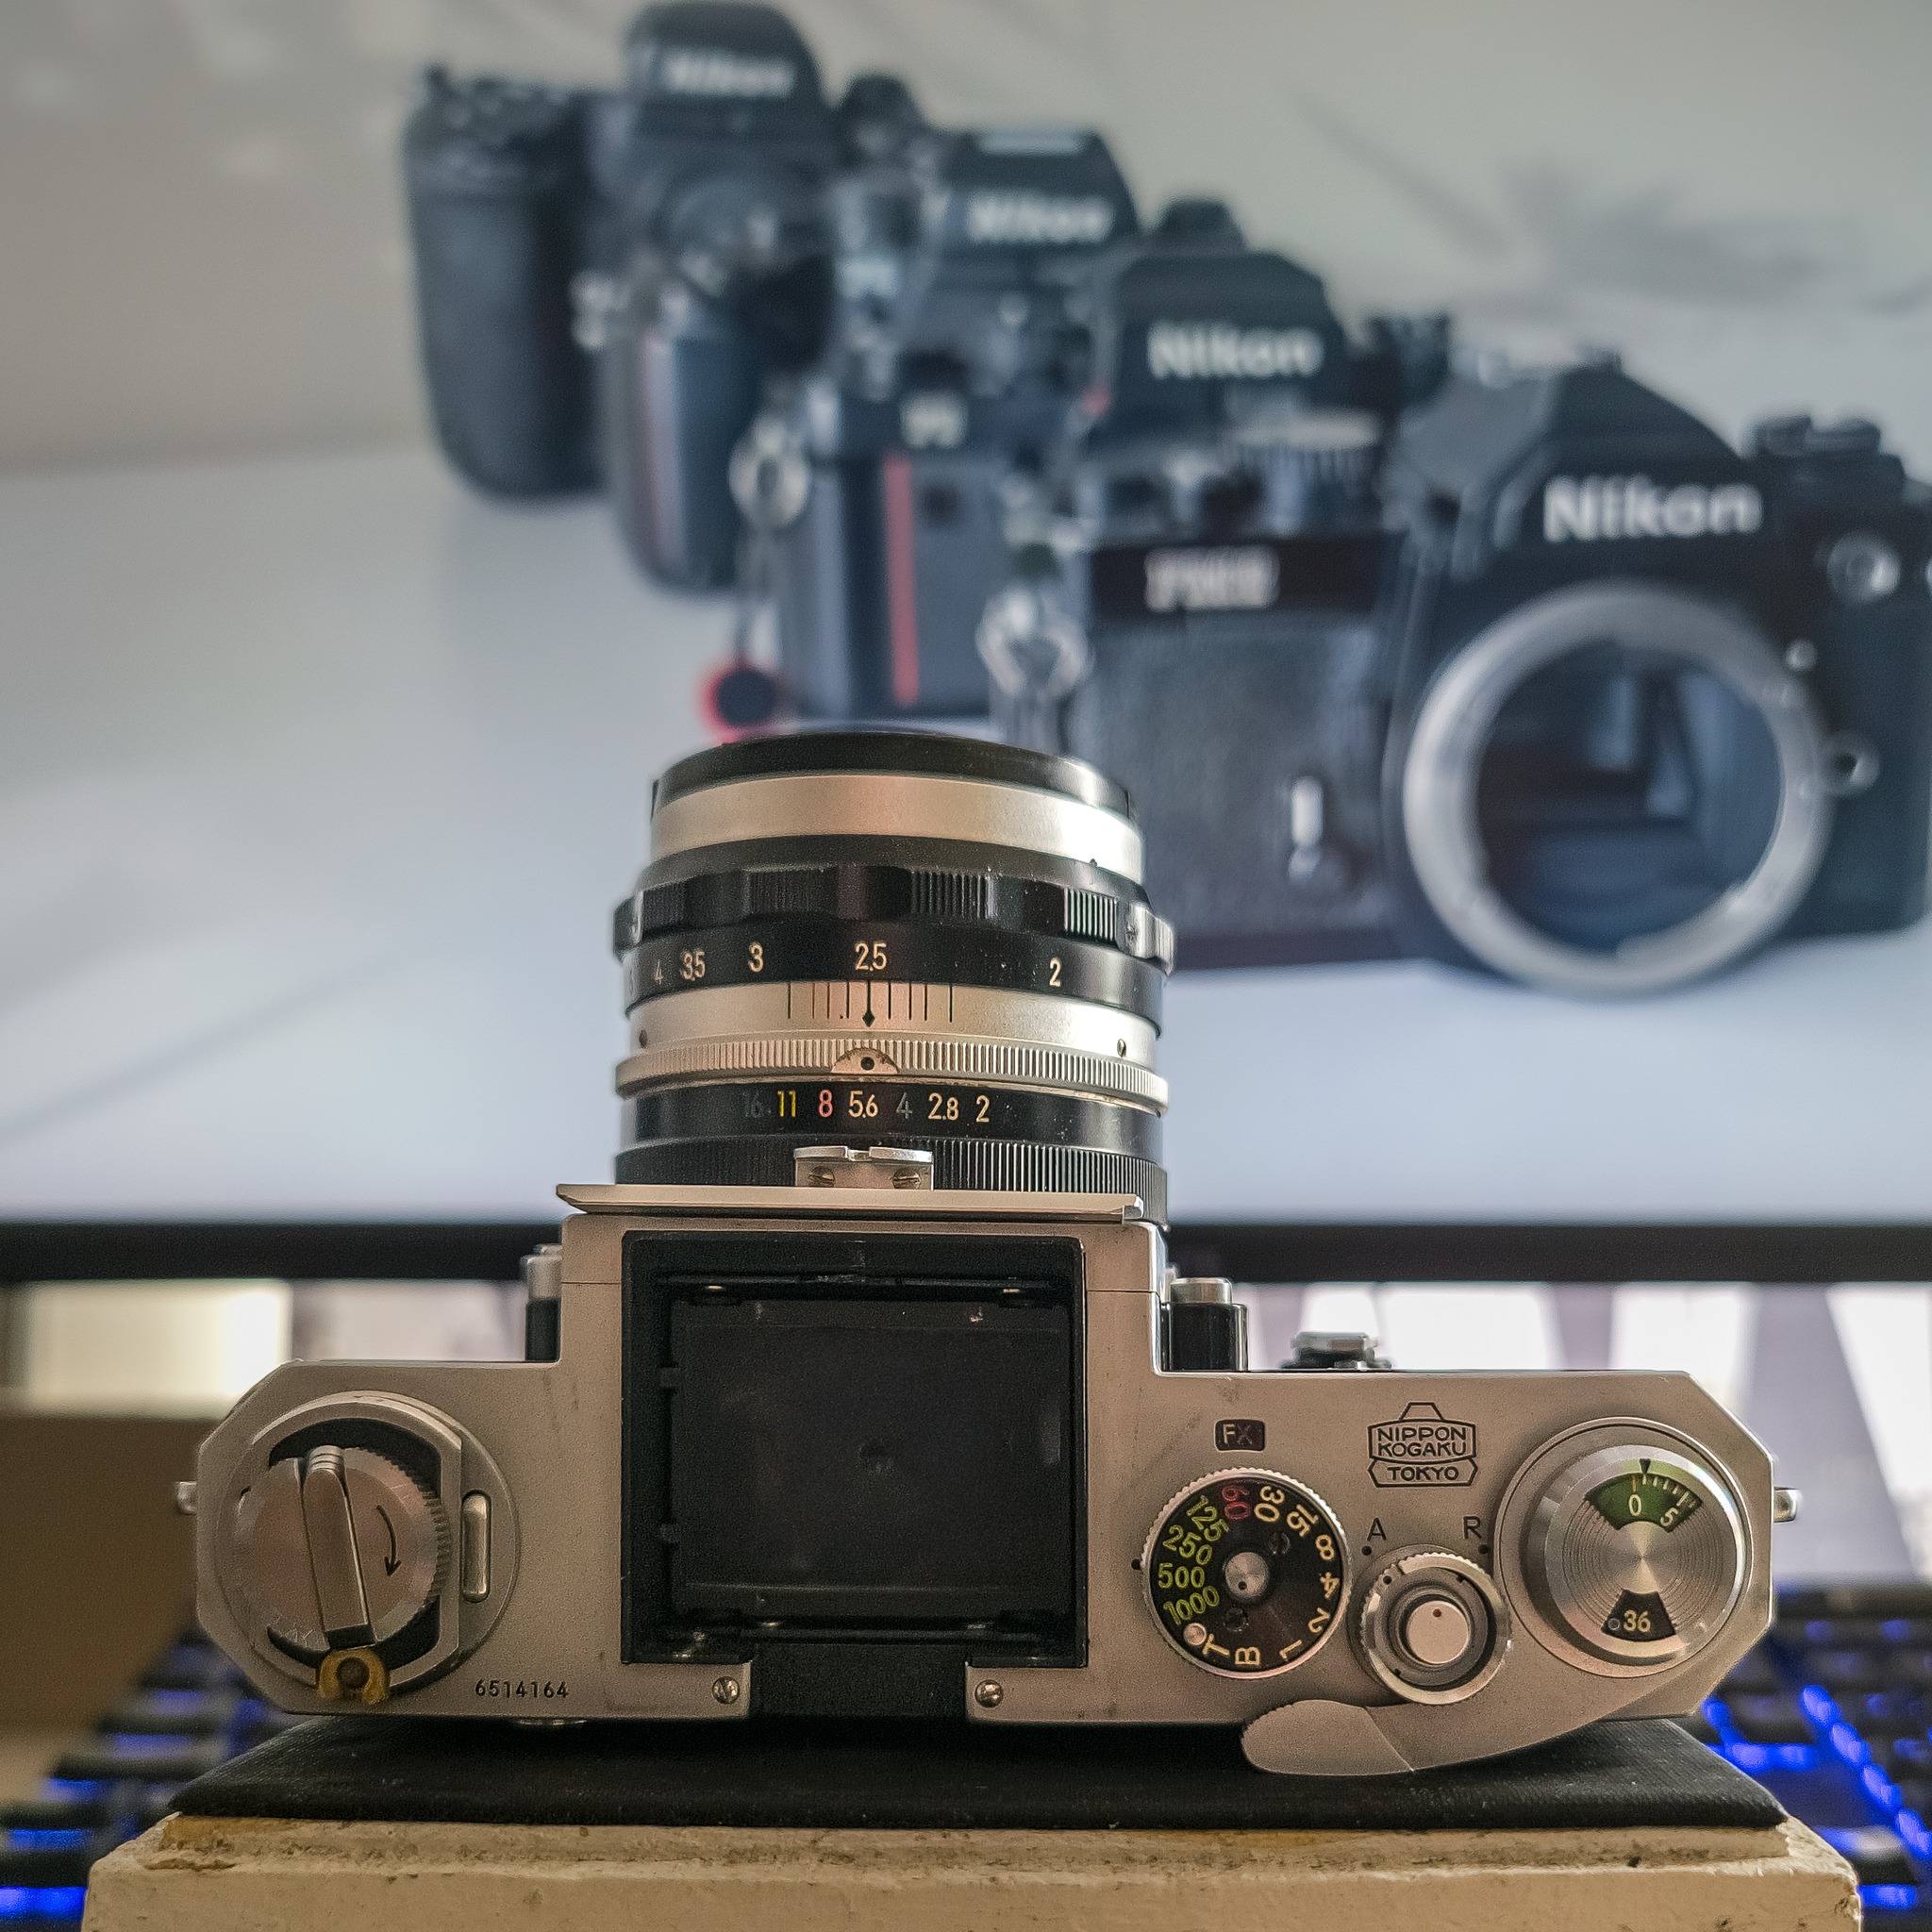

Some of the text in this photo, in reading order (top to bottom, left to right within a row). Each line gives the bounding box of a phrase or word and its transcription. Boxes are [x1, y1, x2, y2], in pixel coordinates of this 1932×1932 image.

[1148, 321, 1323, 378] Nikon
[1543, 475, 1762, 542] Nikon
[748, 942, 764, 973] 3
[1049, 958, 1062, 988] 2
[777, 1090, 796, 1118] 11
[818, 1089, 833, 1118] 8
[895, 1091, 913, 1120] 4
[927, 1092, 959, 1121] 2.8
[975, 1094, 991, 1123] 2
[1376, 1425, 1468, 1442] NIPPON
[1376, 1441, 1468, 1457] KOGAKU
[1386, 1465, 1460, 1482] TOKYO
[1221, 1485, 1253, 1521] 60
[1253, 1485, 1286, 1524] 30
[1659, 1506, 1679, 1527] 5
[1187, 1494, 1230, 1542] 125
[1286, 1504, 1321, 1539] 15
[1368, 1517, 1388, 1541] A
[1463, 1515, 1482, 1540] R
[1162, 1524, 1213, 1566] 250
[1315, 1534, 1336, 1561] 8
[1158, 1562, 1206, 1590] 500
[1319, 1571, 1341, 1600] 4
[1162, 1585, 1221, 1625] 1000
[1307, 1607, 1331, 1634] 2
[1623, 1608, 1652, 1633] 36
[1202, 1633, 1231, 1657] T
[1234, 1646, 1261, 1666] B
[475, 1678, 569, 1699] 6514164
